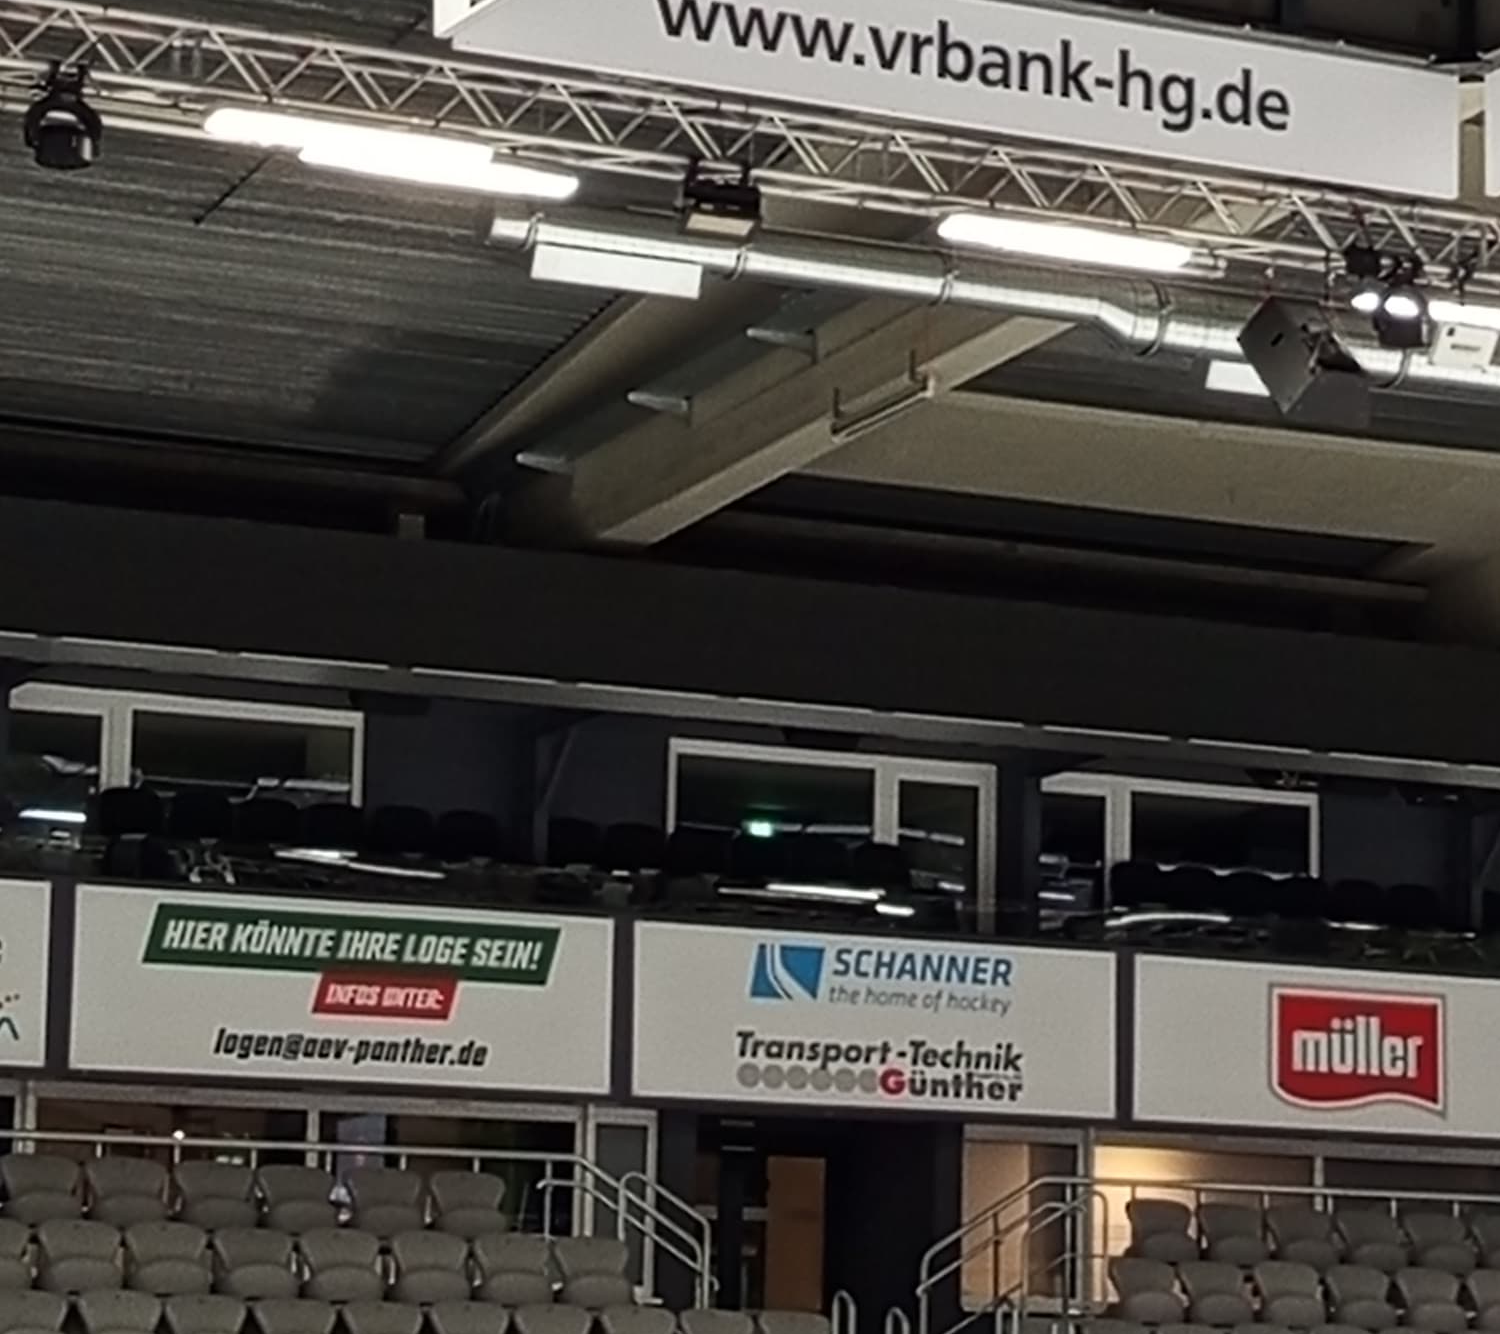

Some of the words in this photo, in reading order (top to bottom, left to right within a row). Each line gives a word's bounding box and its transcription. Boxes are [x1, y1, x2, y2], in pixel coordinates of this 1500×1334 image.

[162, 919, 227, 952] HIER
[231, 919, 336, 958] KÖNNTE
[336, 933, 400, 963] IHRE
[403, 936, 468, 966] LOGE
[471, 941, 543, 971] SEIN!
[832, 947, 1013, 987] SCHANNER
[325, 983, 380, 1007] INFOS
[828, 985, 861, 1004] the
[864, 987, 919, 1008] home
[922, 990, 944, 1014] of
[946, 992, 1012, 1017] hockey
[213, 1027, 489, 1067] logen@aev-panther.de
[1292, 1015, 1423, 1079] müller
[879, 1067, 1023, 1102] Günther
